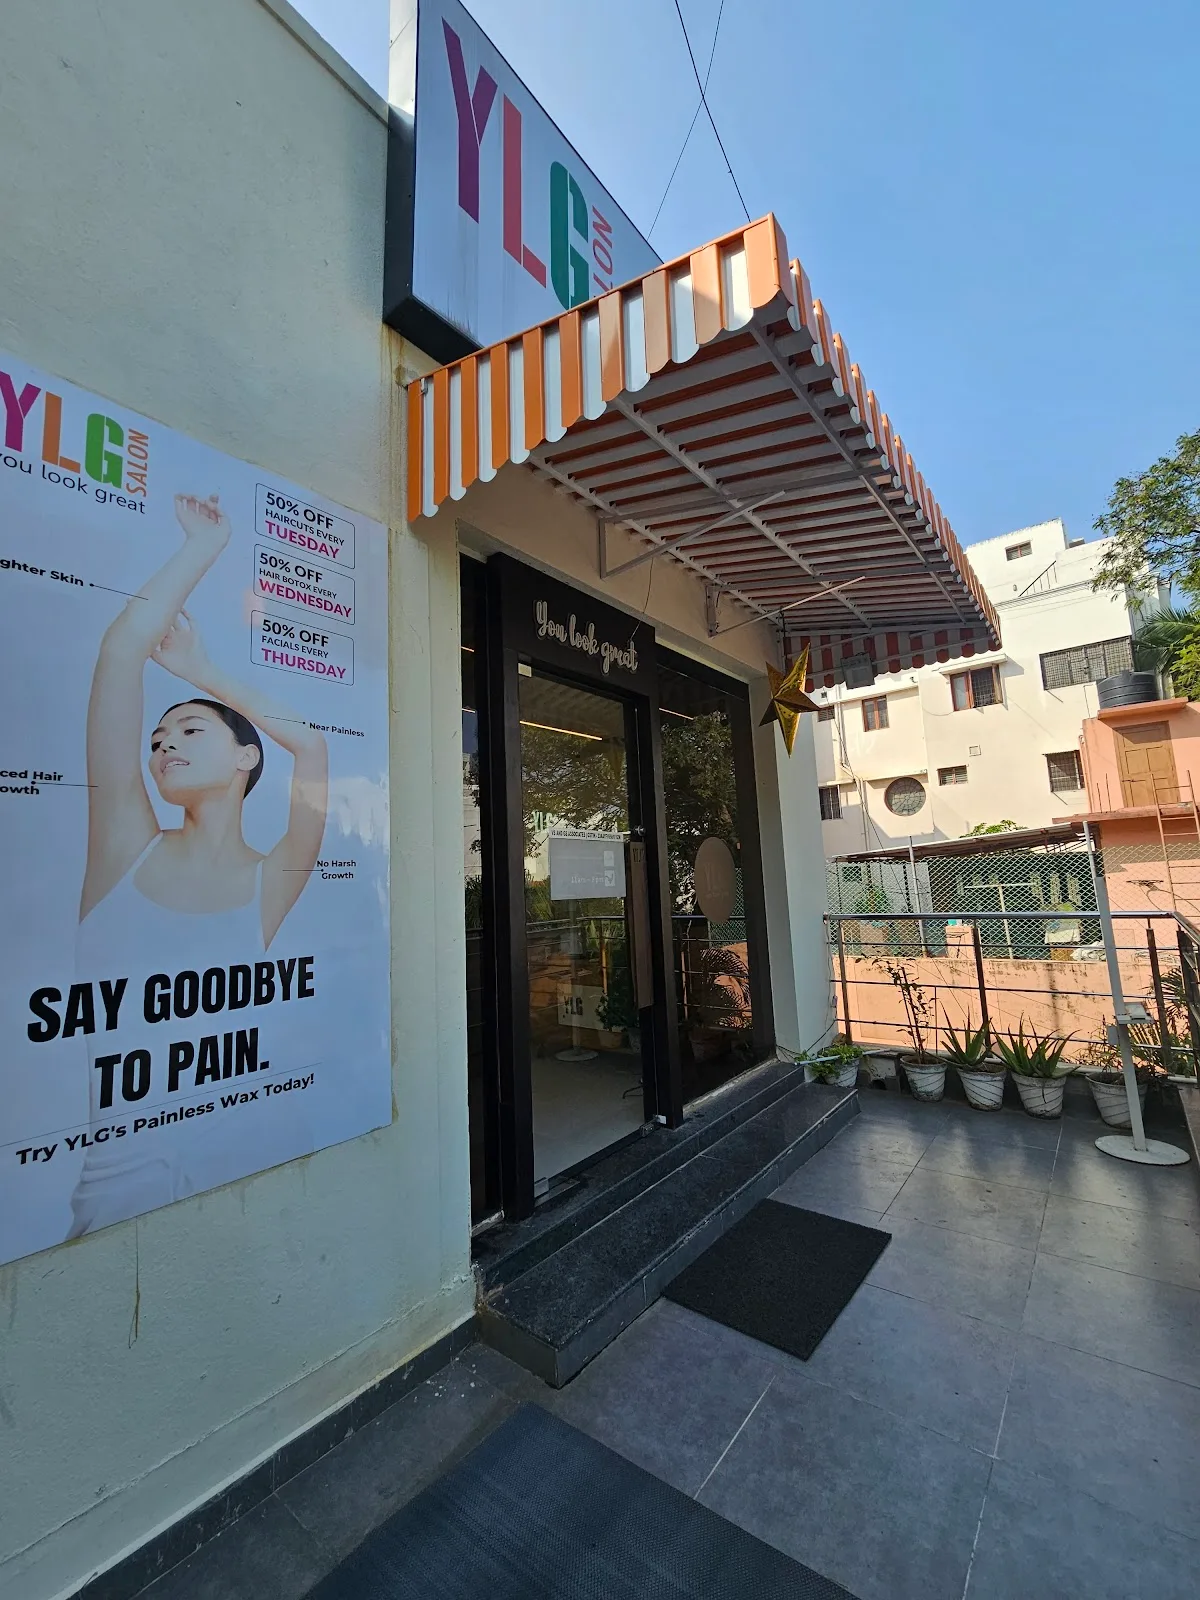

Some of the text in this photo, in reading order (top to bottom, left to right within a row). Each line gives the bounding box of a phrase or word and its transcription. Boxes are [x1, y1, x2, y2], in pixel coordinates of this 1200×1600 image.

[441, 16, 589, 311] YLG
[592, 205, 613, 292] LON
[0, 371, 124, 488] YLG
[126, 429, 149, 498] SALON
[0, 453, 146, 515] ou look great
[265, 508, 345, 547] HAIRCUTS EVERY
[266, 492, 334, 529] 50% OFF
[265, 520, 339, 559] TUESDAY
[0, 558, 84, 587] ghter Skin
[259, 568, 337, 599] HAIR BOTOX EVERY
[260, 552, 323, 583] 50% OFF
[259, 578, 352, 618] WEDNESDAY
[261, 635, 329, 659] FACIALS EVERY
[262, 619, 329, 648] 50% OFF
[535, 600, 639, 674] You look great
[261, 648, 346, 679] THURSDAY
[309, 722, 365, 738] Near Painless
[0, 785, 40, 795] owth
[33, 771, 64, 782] Hair
[321, 871, 354, 880] Growth
[331, 859, 356, 868] Harsh
[27, 956, 315, 1043] SAY GOODBYE
[95, 1027, 270, 1110] TO PAIN.
[15, 1072, 315, 1165] Try YLG's Painless Wax Today!
